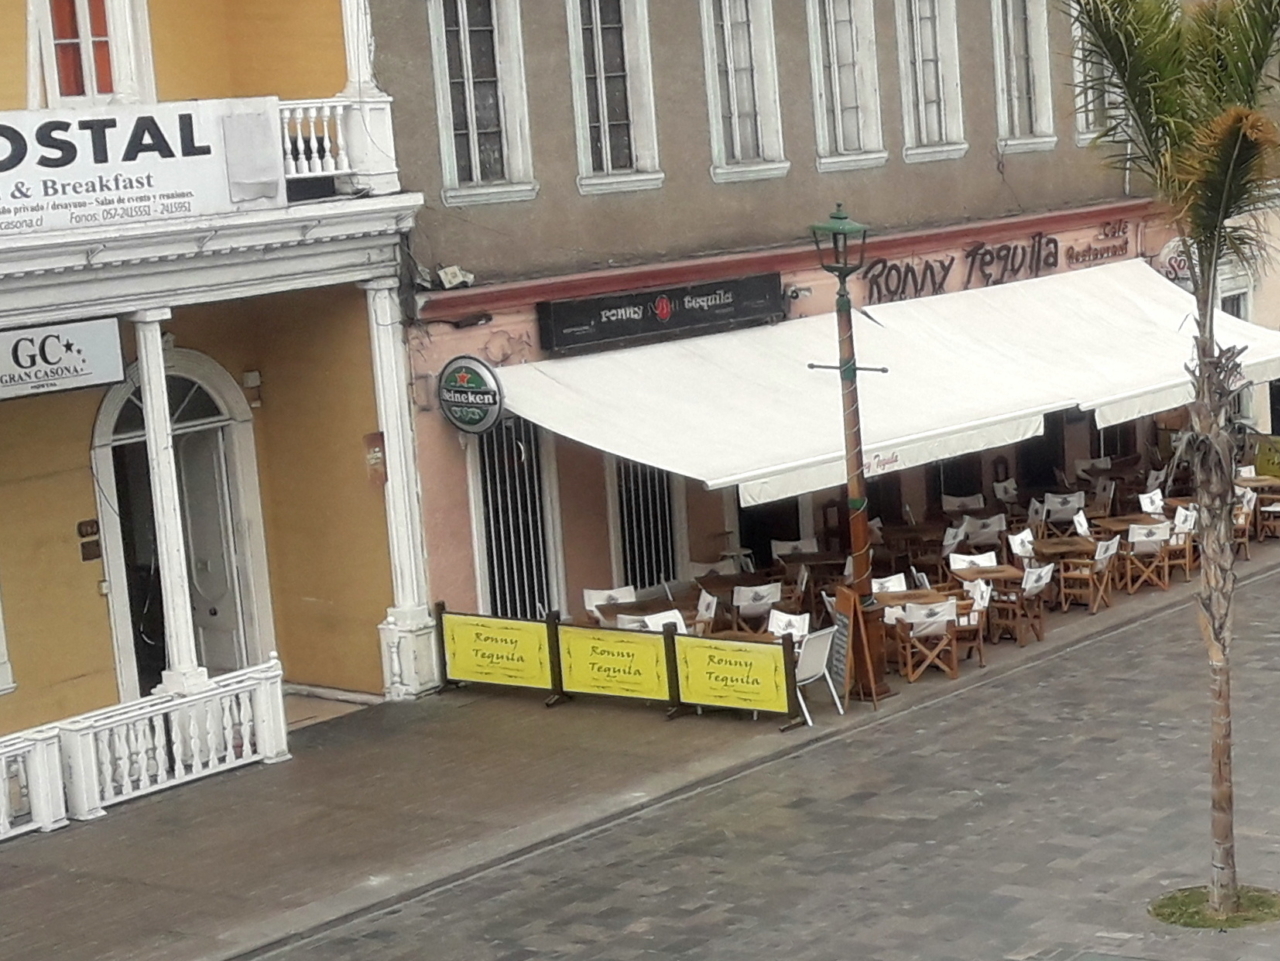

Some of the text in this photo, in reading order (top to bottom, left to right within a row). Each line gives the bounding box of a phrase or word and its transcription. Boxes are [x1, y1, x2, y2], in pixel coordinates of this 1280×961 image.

[10, 171, 154, 199] & Breakfast
[14, 202, 45, 216] privado
[94, 196, 116, 206] Salas
[117, 195, 126, 204] de
[11, 334, 62, 369] GC
[0, 365, 79, 385] GRAN CASONA
[442, 388, 494, 404] Heineken
[474, 632, 518, 651] Ronny
[472, 648, 525, 665] Tequila
[589, 645, 635, 664] Ronny
[707, 654, 753, 674] Ronny
[588, 662, 642, 678] Tequila
[705, 671, 761, 688] Tequila
